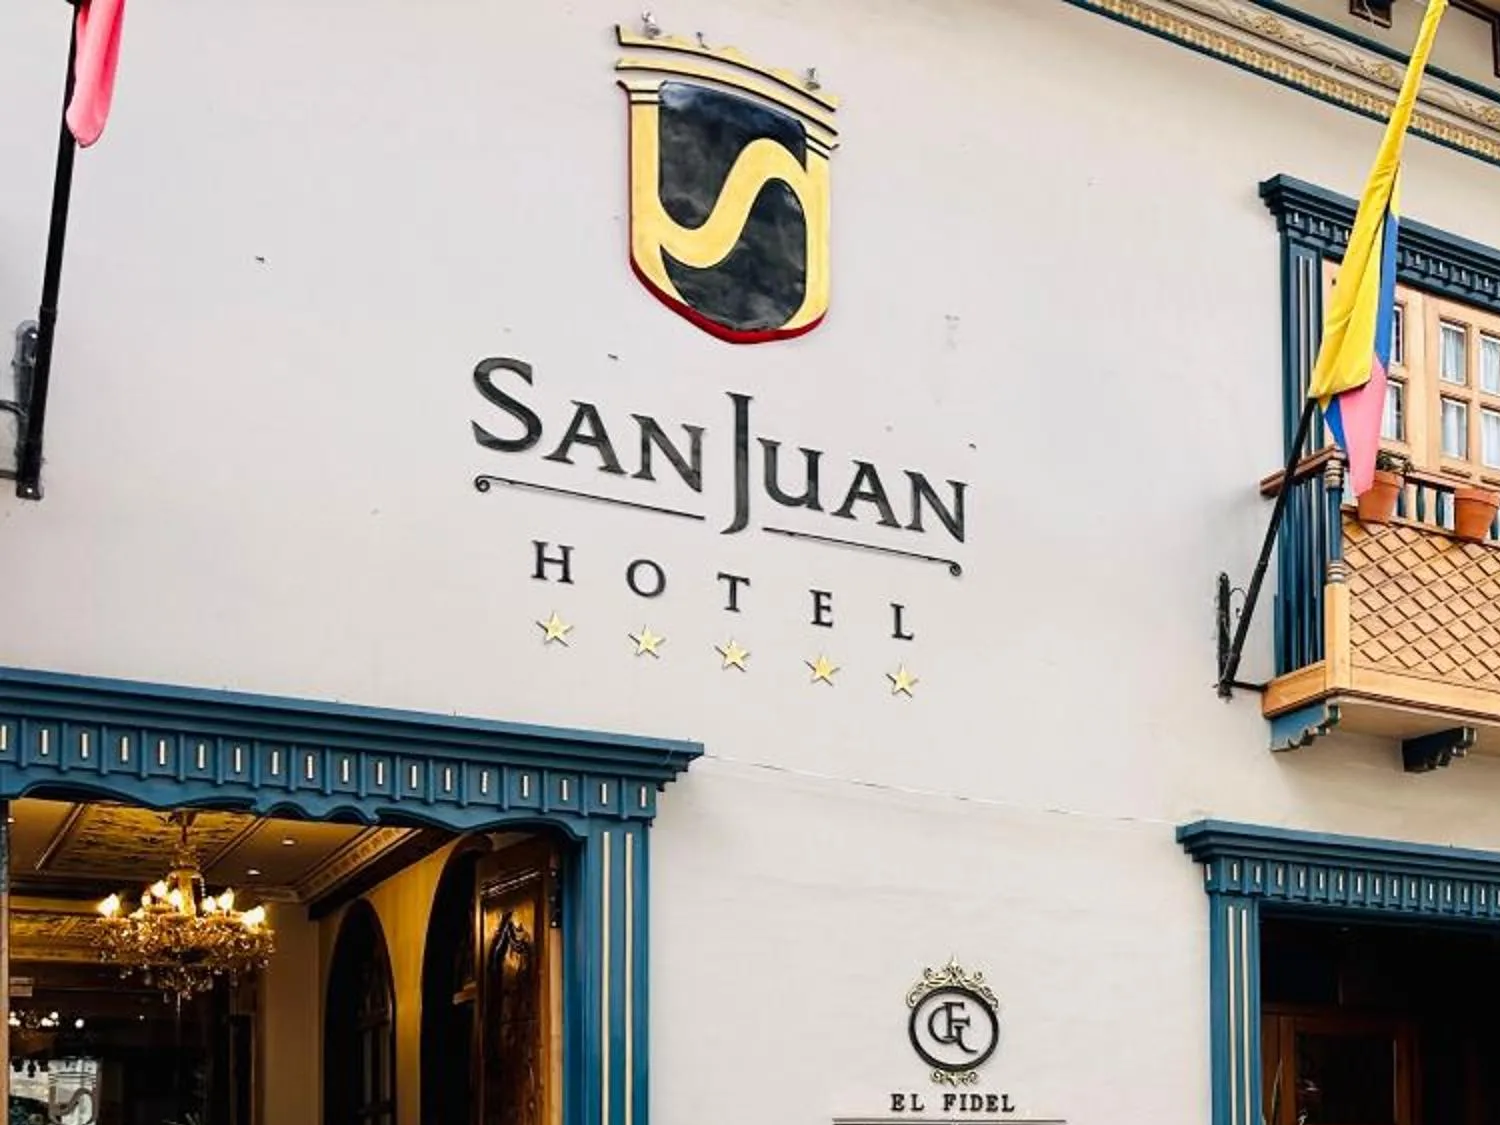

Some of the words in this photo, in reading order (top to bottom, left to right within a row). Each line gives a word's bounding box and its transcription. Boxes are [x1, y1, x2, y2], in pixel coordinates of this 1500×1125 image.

[530, 540, 915, 641] HOTEL
[890, 1094, 925, 1112] EL
[943, 1094, 1015, 1112] FIDEL
